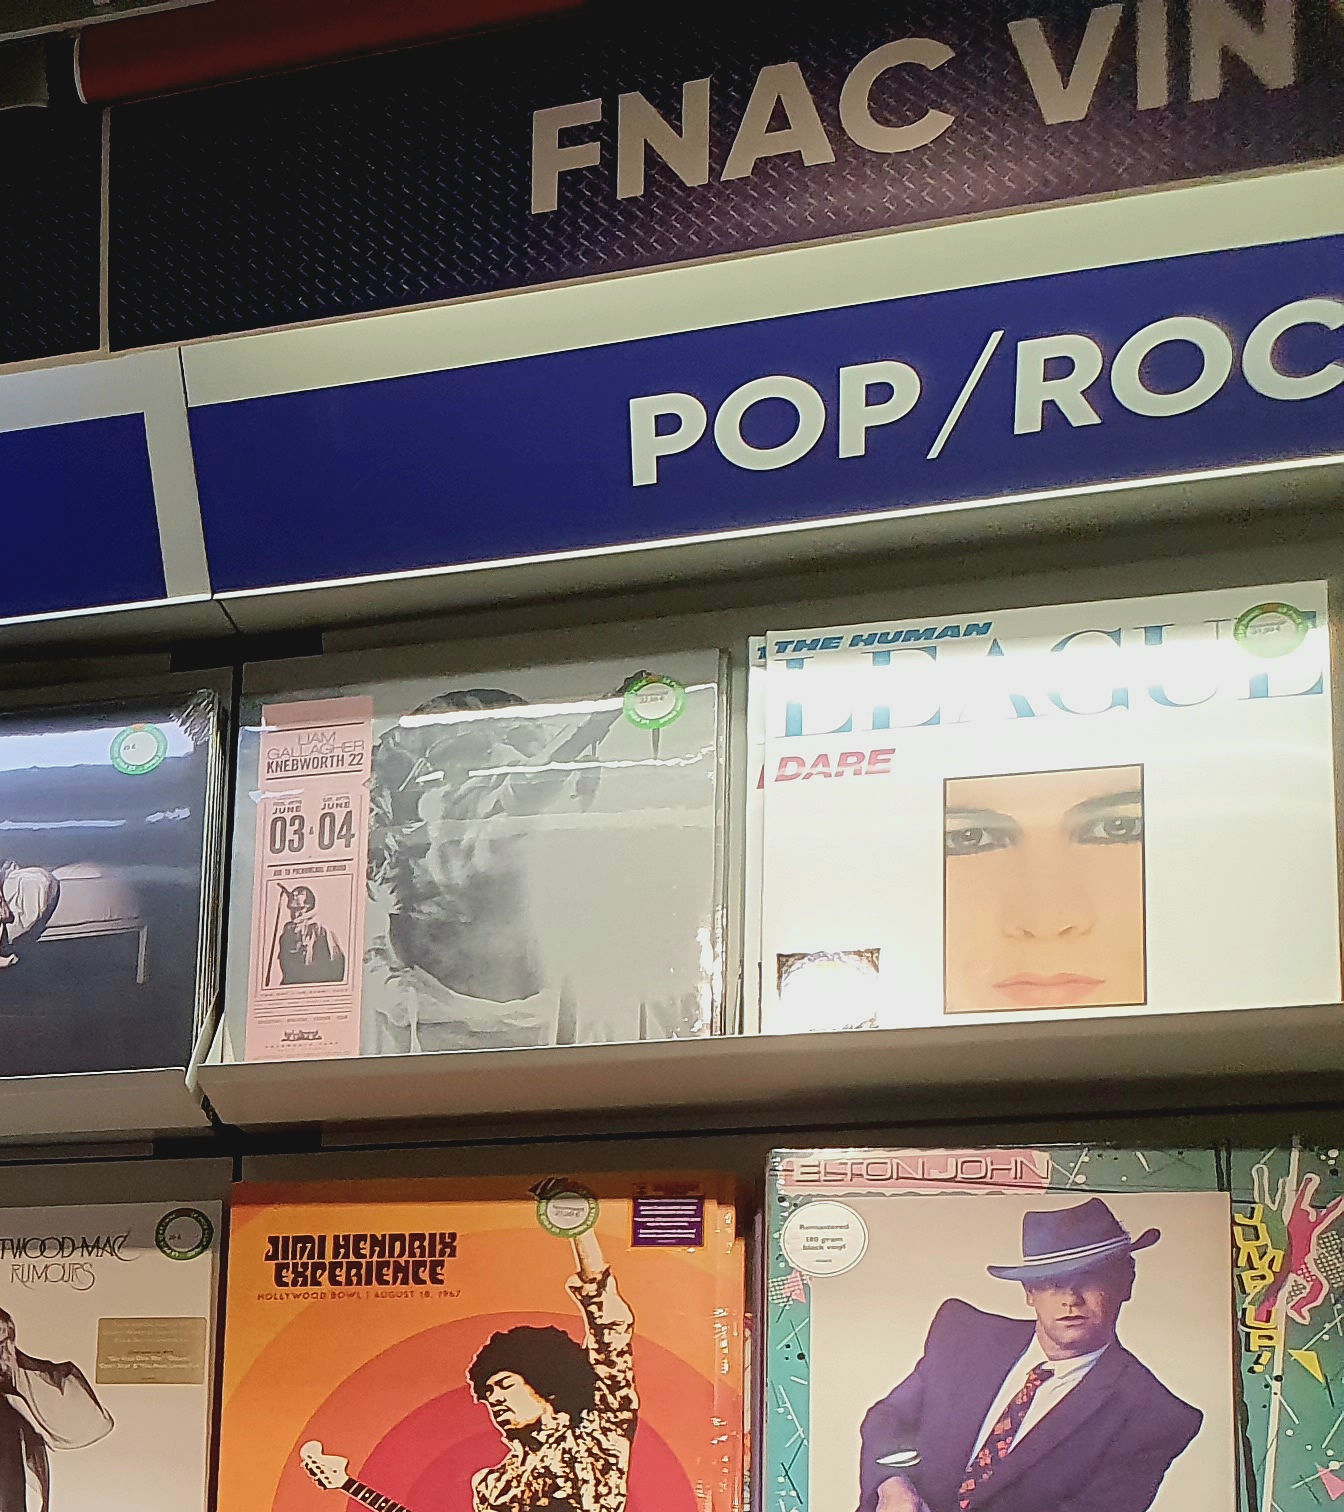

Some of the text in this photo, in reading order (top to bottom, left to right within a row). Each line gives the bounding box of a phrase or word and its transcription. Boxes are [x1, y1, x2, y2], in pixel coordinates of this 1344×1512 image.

[531, 37, 956, 214] FNAC
[629, 297, 1344, 487] POP/ROC
[775, 621, 993, 654] THE HUMAN
[267, 740, 364, 760] GALLAGHER
[298, 732, 336, 745] LIAM
[266, 753, 364, 774] KNEBWORTH 22
[775, 748, 896, 783] DARE
[272, 806, 301, 814] JUNE
[321, 801, 350, 810] JUNE
[269, 810, 355, 854] 03 04
[792, 1156, 1050, 1182] ELTON JOHN
[78, 1229, 142, 1262] MAC
[264, 1232, 458, 1261] JIMI HENDRIX
[10, 1262, 96, 1291] RUMOURS
[274, 1259, 446, 1288] EXPERIENCE
[257, 1292, 327, 1301] HOLLYWOOD
[374, 1290, 414, 1299] AUGUST
